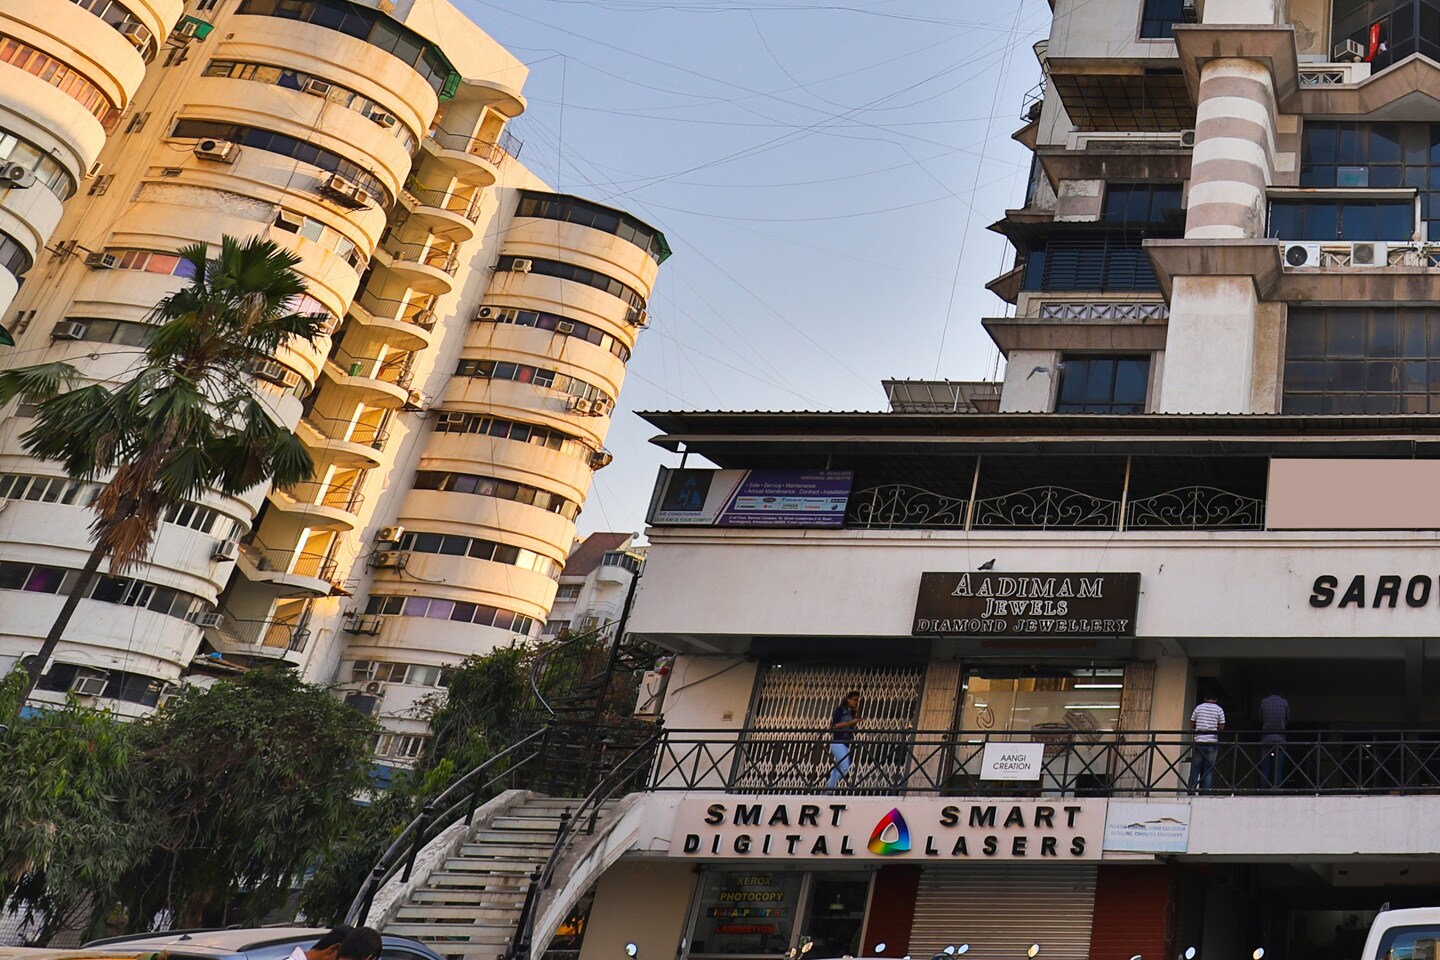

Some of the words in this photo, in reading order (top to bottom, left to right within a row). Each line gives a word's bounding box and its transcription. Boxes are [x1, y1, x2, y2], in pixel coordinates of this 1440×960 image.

[951, 572, 1104, 598] AADIMAM
[981, 598, 1068, 618] JEWELS
[917, 619, 1007, 632] DIAMOND
[1012, 619, 1128, 633] JEWELLERY
[992, 762, 1031, 770] CREATION
[1000, 754, 1027, 762] AANGI
[704, 804, 847, 827] SMART
[939, 805, 1082, 828] SMART
[683, 834, 855, 855] DIGITAL
[924, 835, 1087, 856] LASERS
[737, 876, 772, 886] XEROX
[720, 892, 784, 901] PHOTOCOPY
